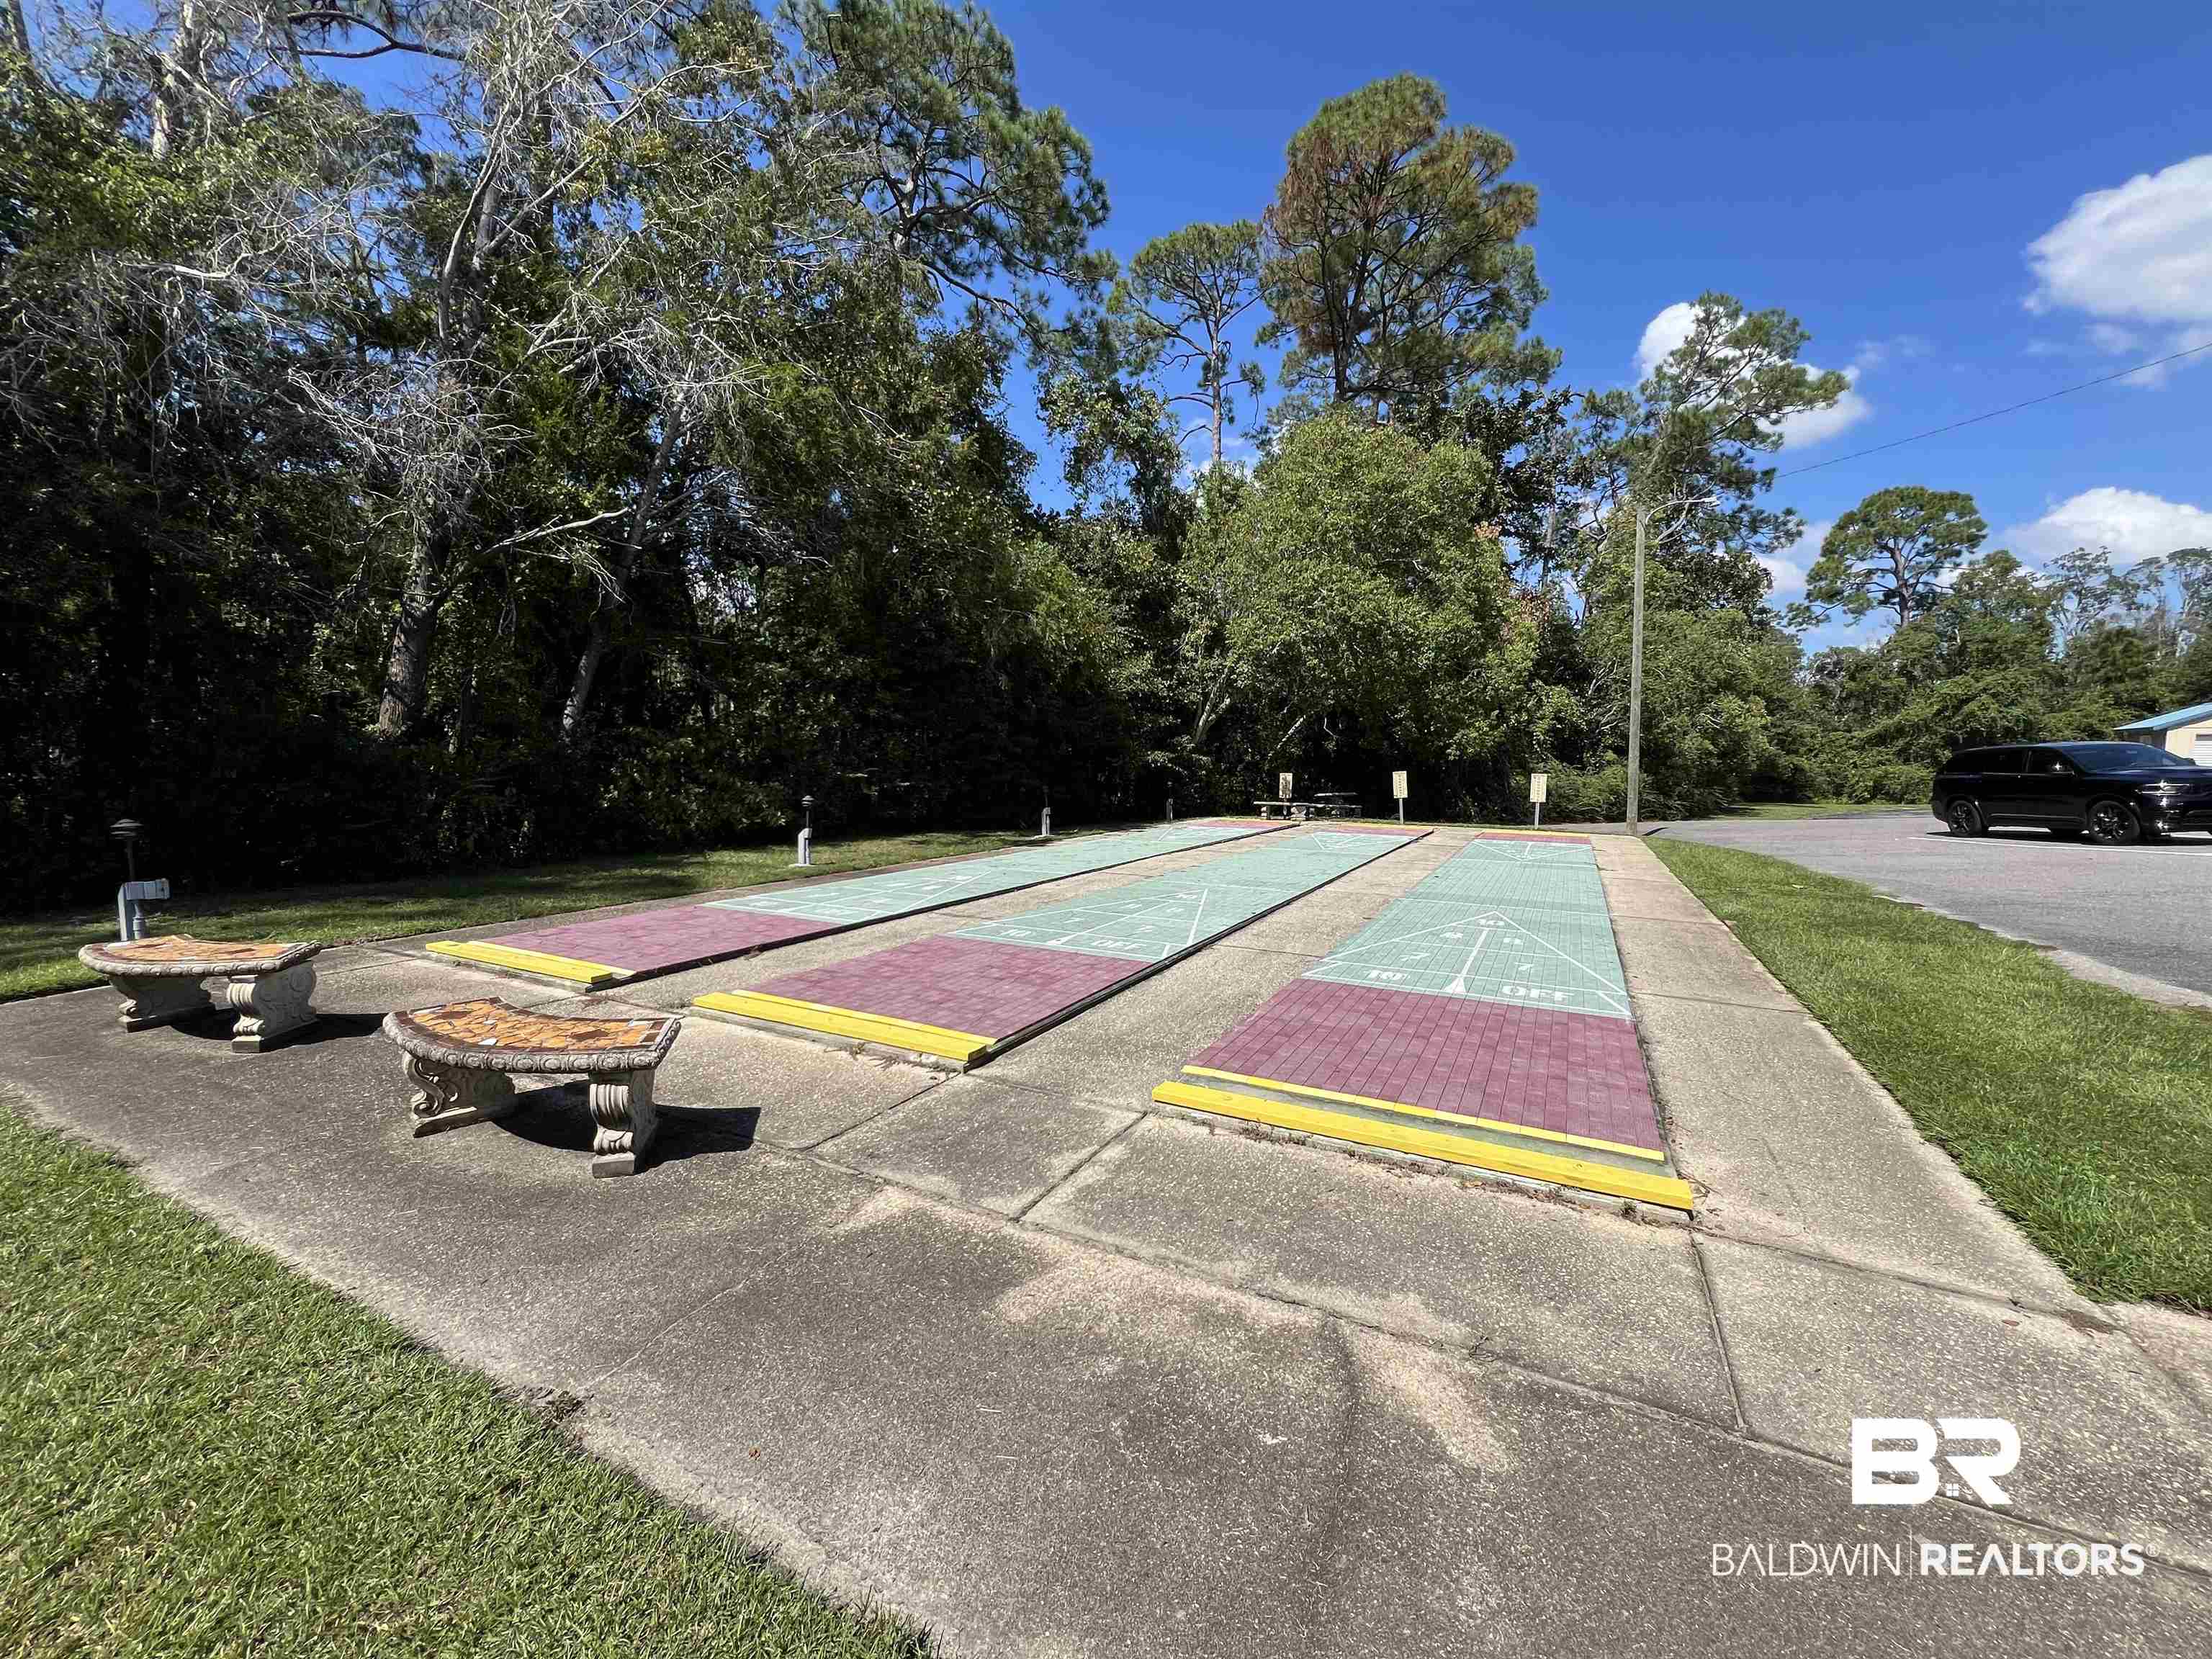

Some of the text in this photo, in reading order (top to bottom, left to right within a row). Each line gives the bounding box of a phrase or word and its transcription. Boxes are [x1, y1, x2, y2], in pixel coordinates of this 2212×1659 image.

[1090, 939, 1147, 950] OFF
[1514, 962, 1534, 971] 7
[1501, 985, 1575, 1002] OFF
